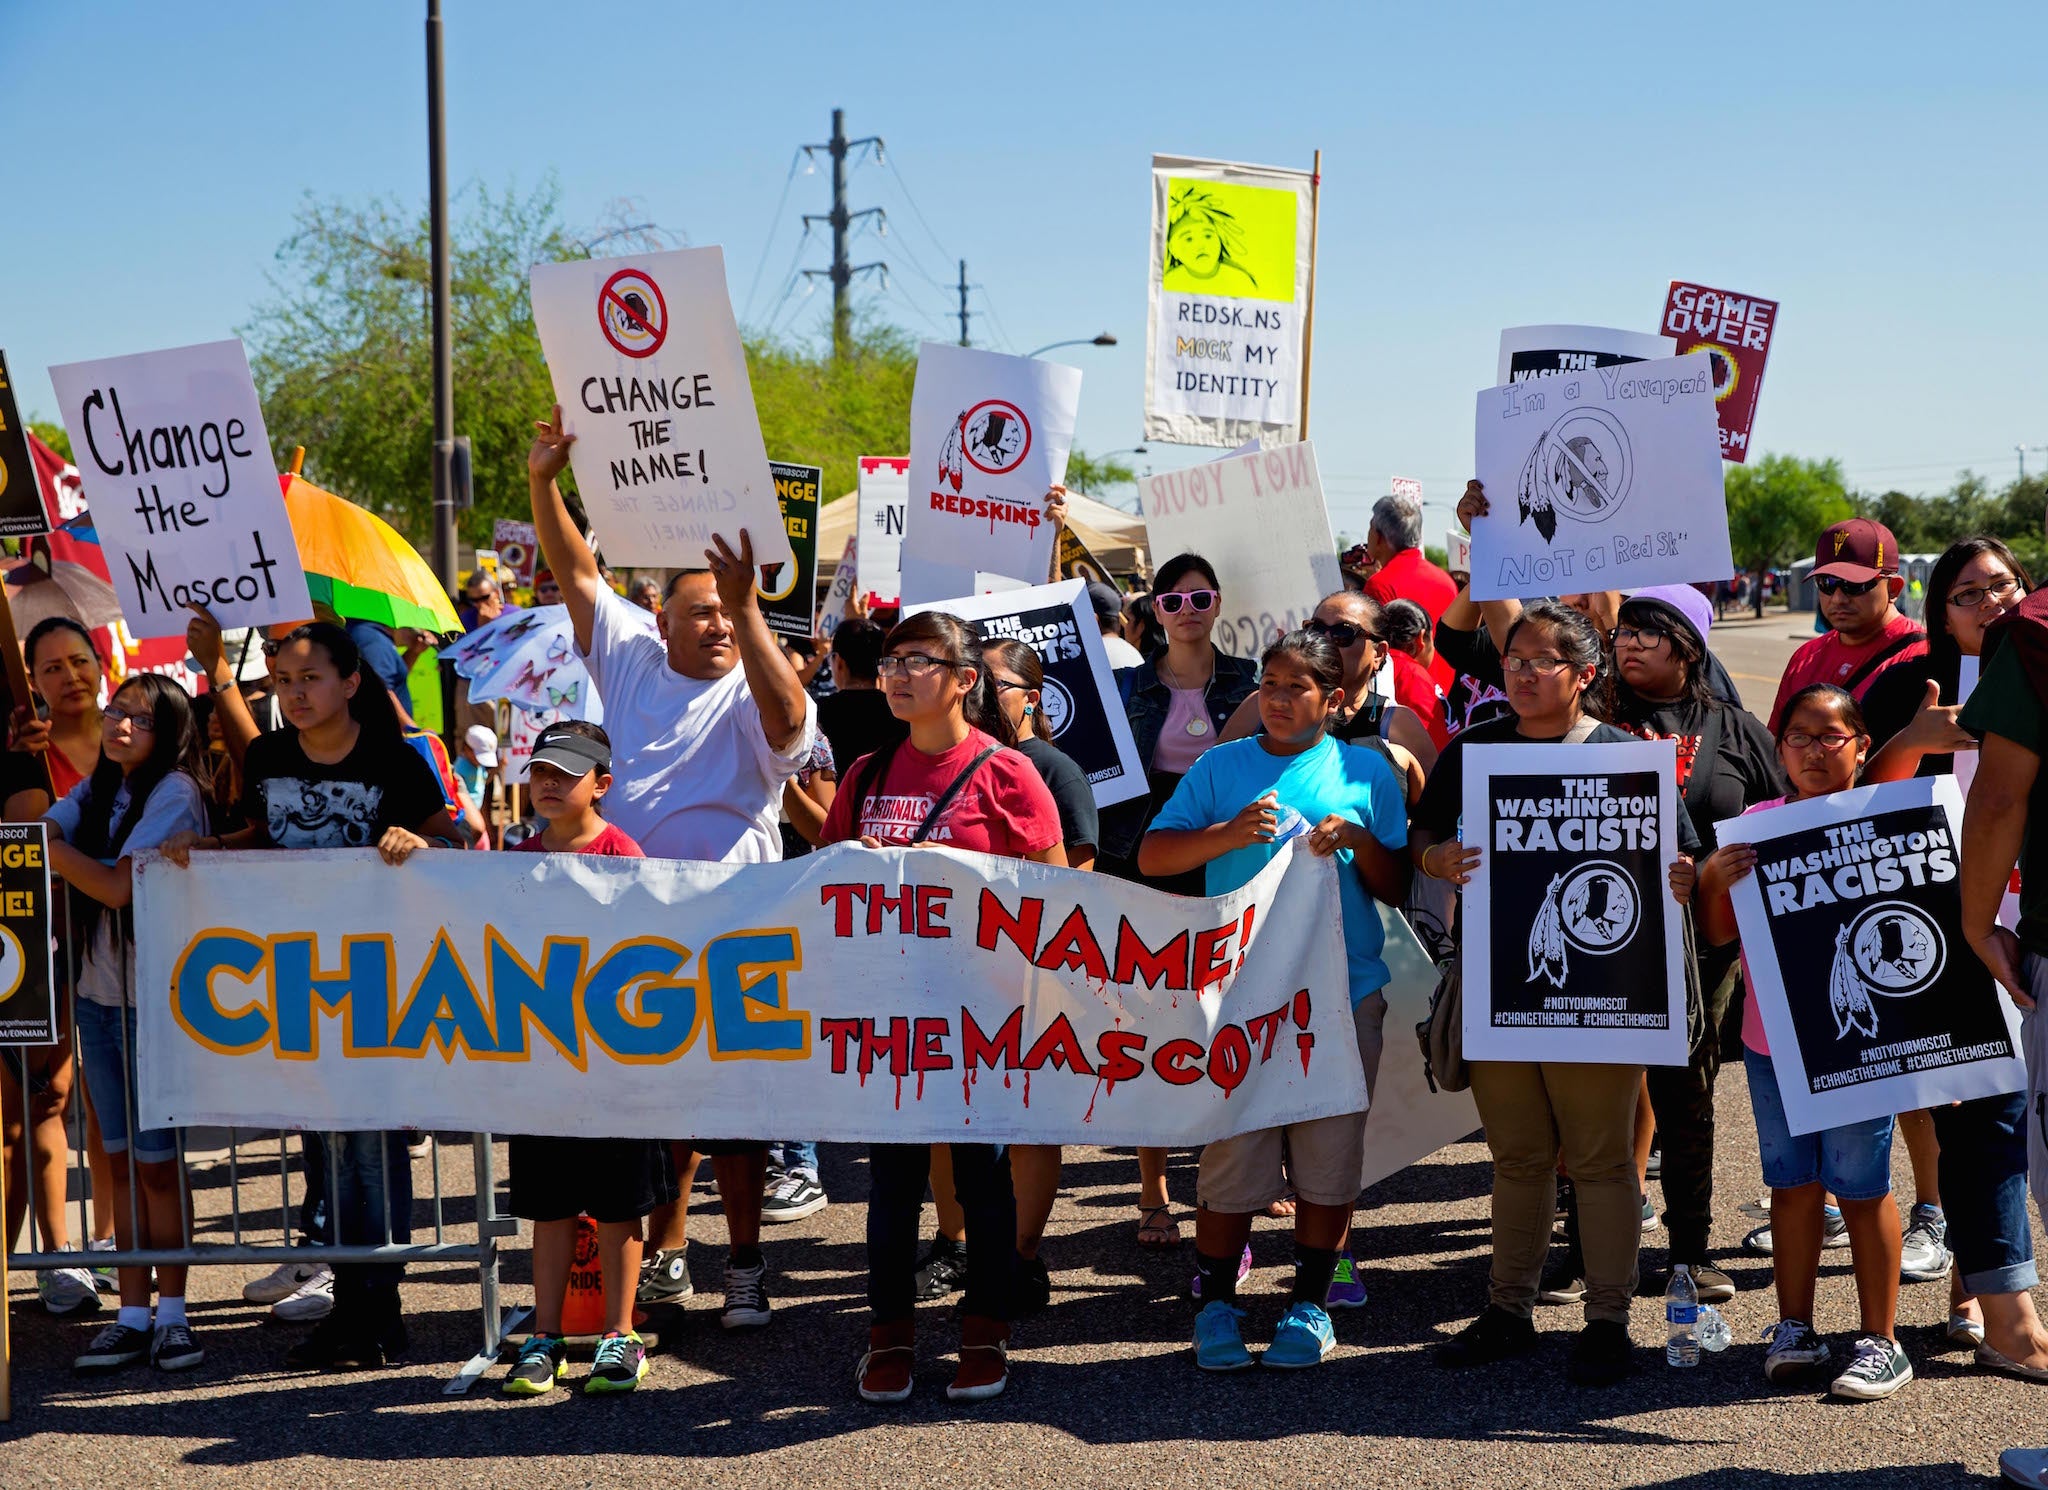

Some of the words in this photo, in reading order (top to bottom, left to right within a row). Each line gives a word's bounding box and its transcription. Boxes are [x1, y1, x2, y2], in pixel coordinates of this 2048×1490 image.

[1178, 302, 1281, 330] REDSK_NS
[1672, 285, 1773, 328] GAME
[1666, 308, 1767, 351] OVER
[1176, 336, 1232, 362] MOCK
[1245, 344, 1279, 365] MY
[1558, 353, 1598, 370] THE
[581, 374, 716, 414] CHANGE
[1176, 371, 1279, 398] IDENTITY
[1564, 381, 1580, 400] a
[1596, 365, 1707, 404] Yavapai
[82, 387, 252, 498] Change
[628, 420, 671, 450] THE
[610, 449, 709, 491] NAME!
[775, 479, 817, 502] NGE
[134, 485, 209, 534] the
[930, 491, 1041, 529] REDSKINS
[125, 531, 277, 613] Mascot
[1497, 549, 1575, 586] NOT
[1585, 546, 1605, 571] a
[984, 615, 1023, 636] THE
[1561, 778, 1609, 798] THE
[863, 798, 928, 823] CARDINALS
[1496, 795, 1657, 818] WASHINGTON
[1496, 817, 1658, 852] RACISTS
[1824, 821, 1877, 844] THE
[1762, 828, 1949, 883] WASHINGTON
[1764, 850, 1957, 916] RACISTS
[820, 884, 953, 938] THE
[975, 886, 1256, 993] NAME!
[169, 923, 812, 1072] CHANGE
[1543, 996, 1628, 1011] #NOTYOURMASCOT
[1494, 1011, 1579, 1026] #CHANGETHENAME
[1583, 1011, 1667, 1028] #CHANGETHEMASCOT
[820, 1016, 953, 1077] THE
[961, 988, 1313, 1097] MASCOT!
[1860, 1033, 1952, 1064] #NOTYOURMASCOT
[1813, 1060, 1904, 1090] #CHANGETHENAME
[1905, 1040, 2010, 1072] #CHANGETHEMASCOT
[571, 1271, 602, 1290] RIDE
